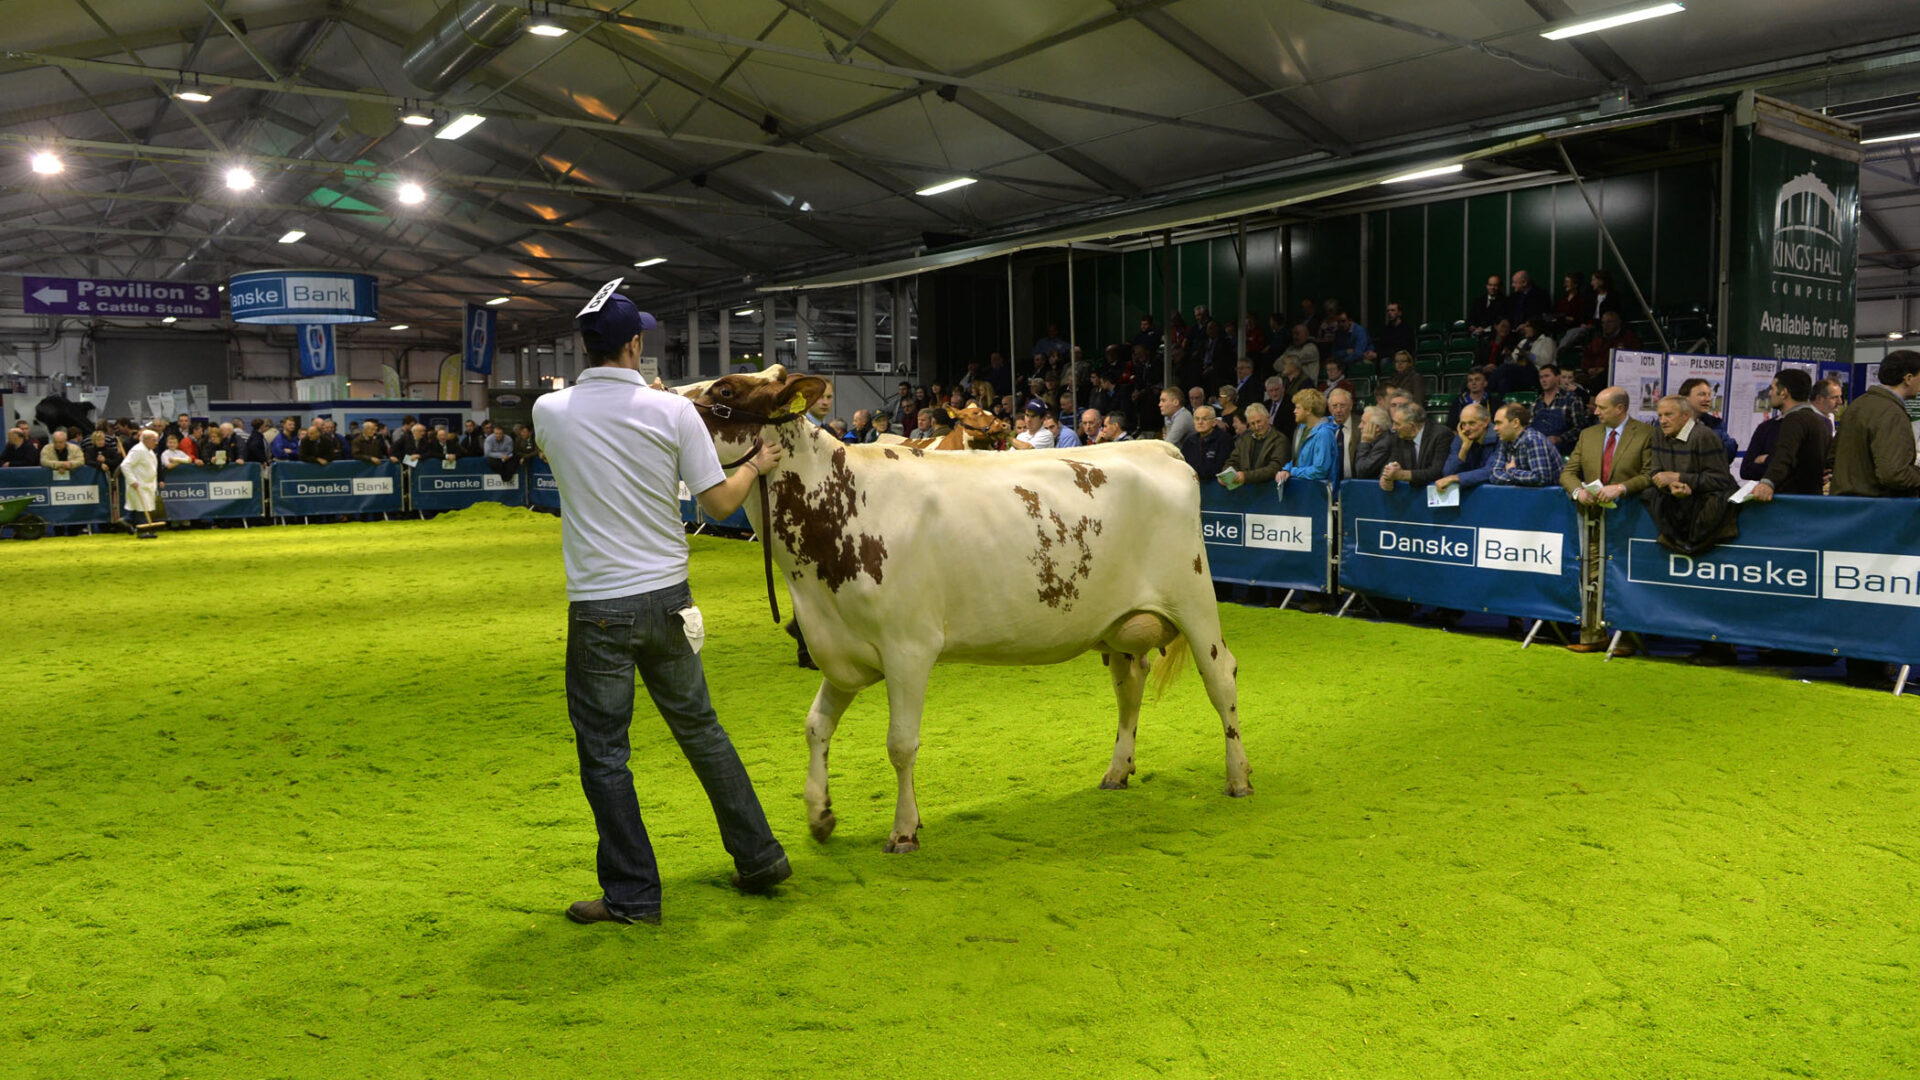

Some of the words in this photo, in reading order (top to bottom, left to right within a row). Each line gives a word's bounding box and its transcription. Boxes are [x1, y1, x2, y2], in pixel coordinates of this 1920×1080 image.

[1813, 246, 1842, 276] HALL
[77, 281, 185, 300] Pavilion
[194, 285, 211, 300] 3
[294, 286, 350, 301] Bank
[77, 302, 90, 311] &
[96, 302, 150, 313] Cattle
[155, 304, 204, 315] Stalls
[1760, 310, 1811, 337] Available
[1812, 316, 1828, 337] for
[1829, 318, 1849, 338] Hire
[1641, 356, 1655, 367] IOTA
[1690, 359, 1725, 370] PILSNER
[1752, 362, 1776, 373] BARNEY
[297, 483, 349, 495] Danske
[356, 482, 389, 492] Bank
[434, 478, 481, 489] Danske
[55, 491, 94, 502] Bank
[155, 489, 206, 498] anske
[213, 486, 249, 497] Bank
[1203, 521, 1238, 539] ske
[1251, 523, 1304, 544] Bank
[1379, 530, 1469, 558] Danske
[1485, 539, 1553, 565] Bank
[1668, 553, 1808, 587] Danske
